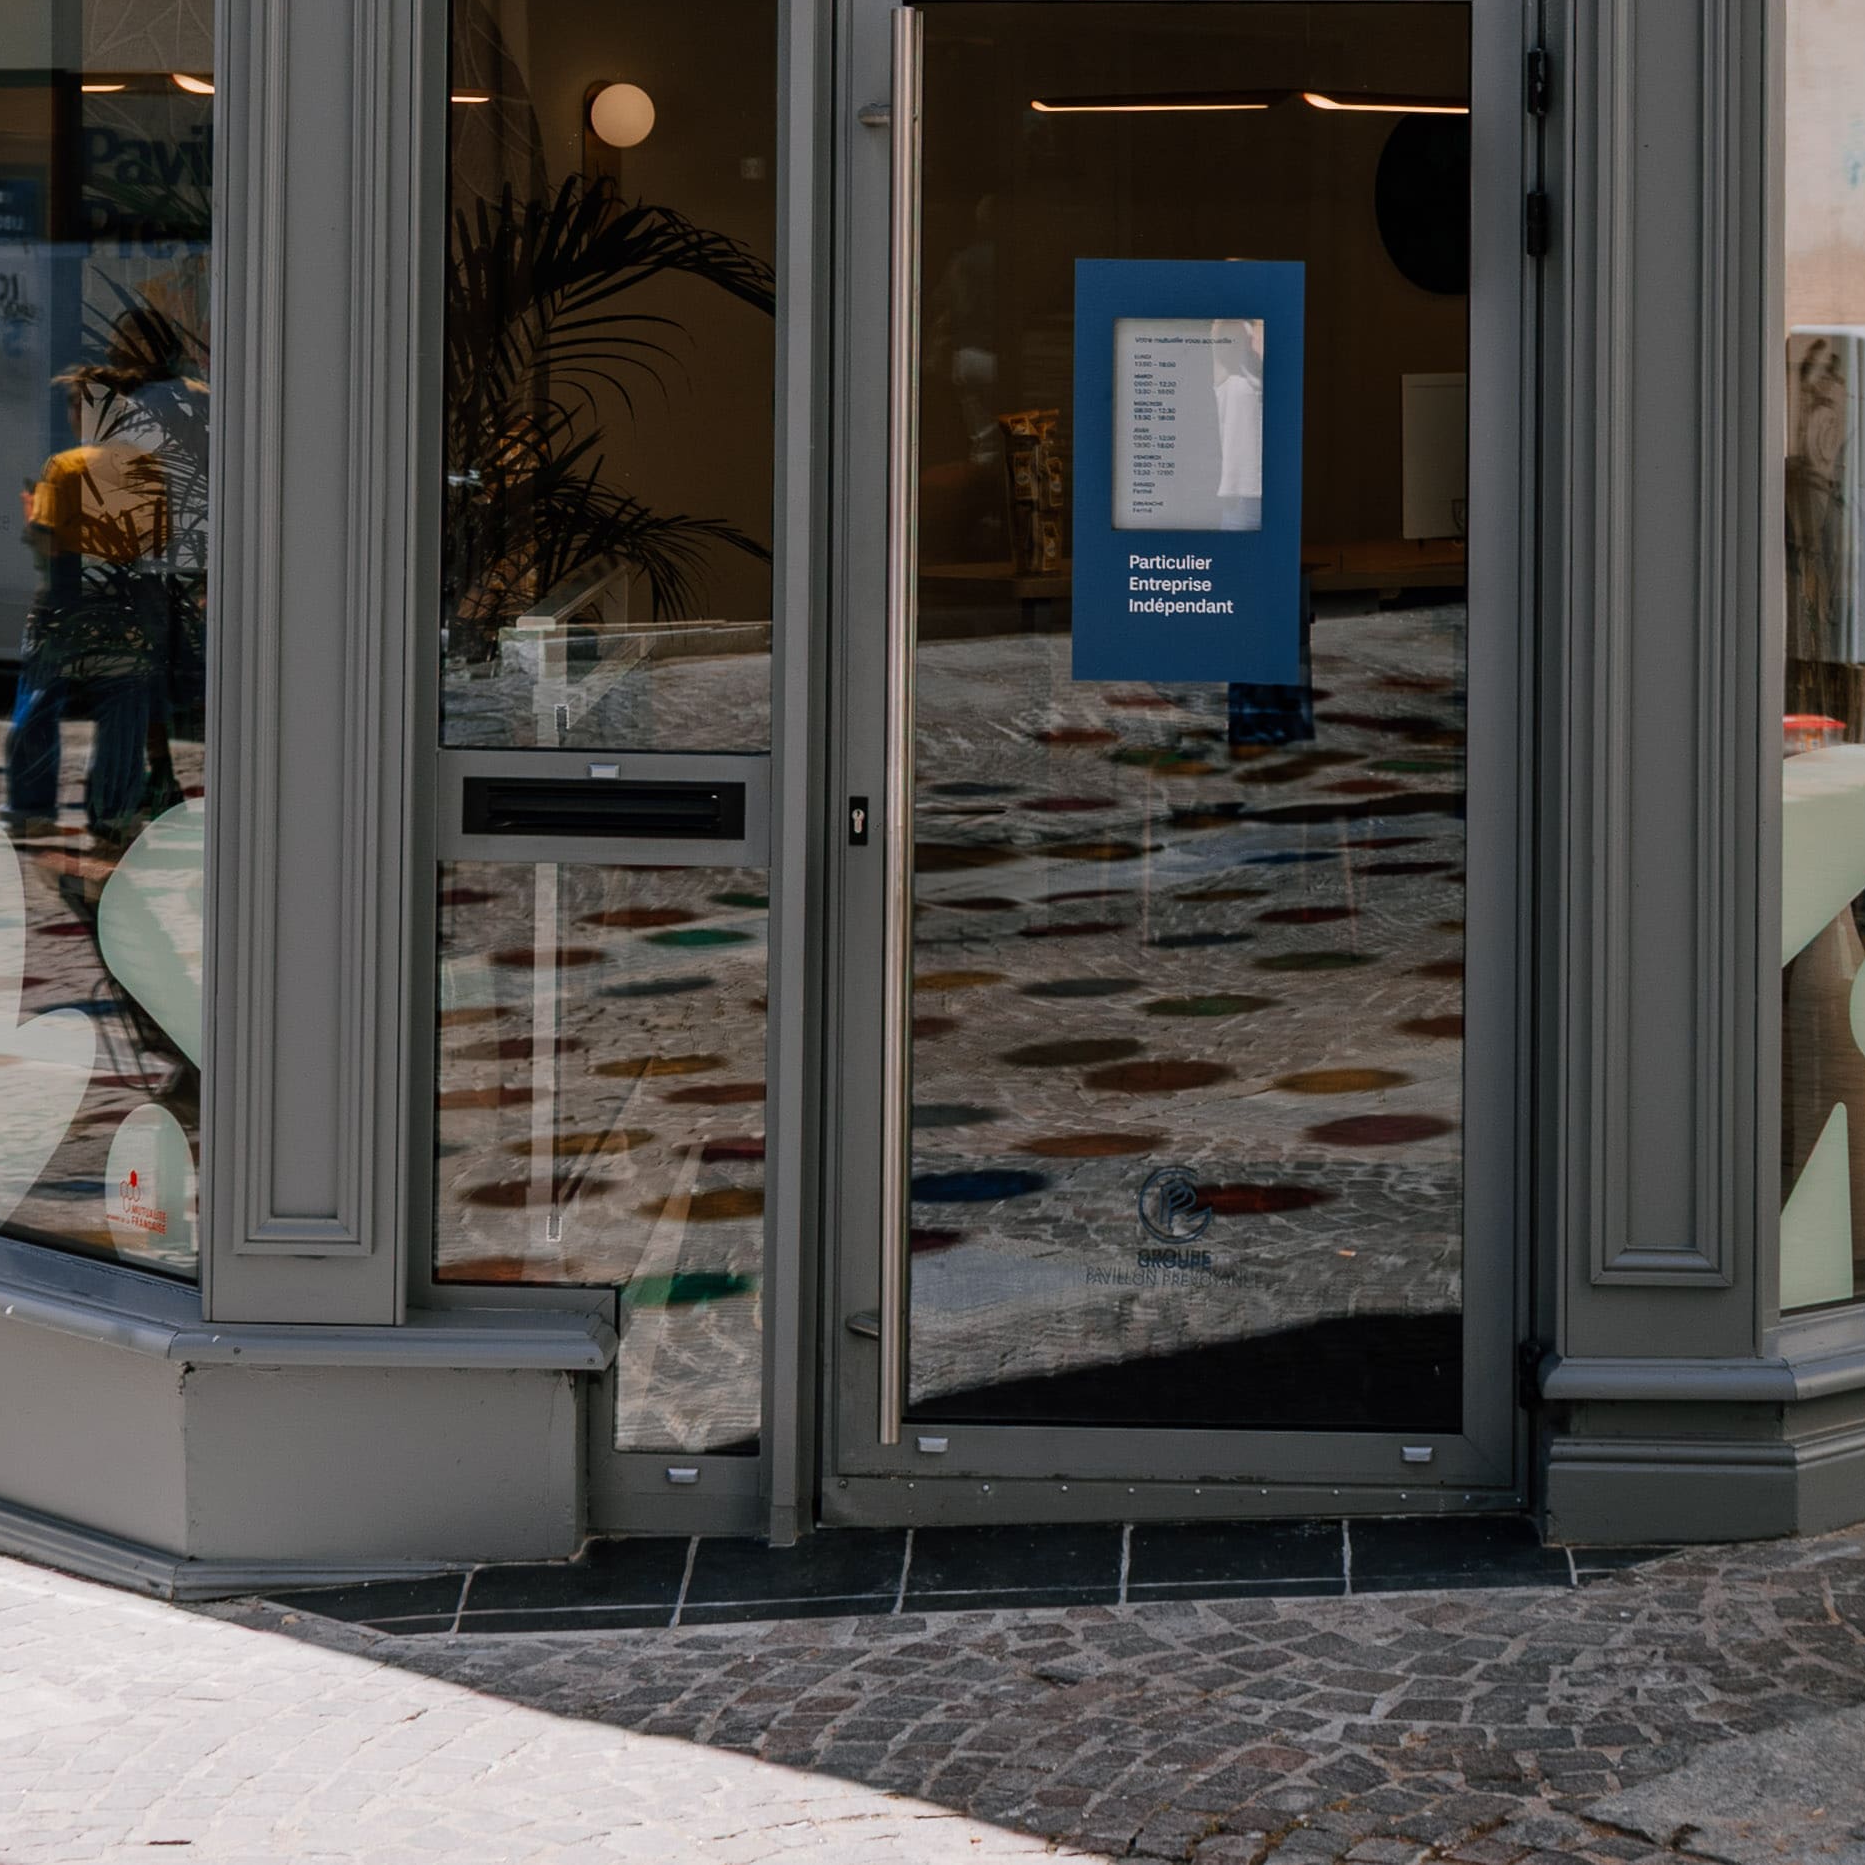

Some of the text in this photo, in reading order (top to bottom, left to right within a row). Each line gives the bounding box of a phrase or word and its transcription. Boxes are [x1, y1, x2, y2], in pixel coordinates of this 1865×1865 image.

[1129, 554, 1213, 570] Particulier
[1129, 576, 1212, 595] Entreprise
[1129, 597, 1234, 617] Indépendant
[1138, 1249, 1211, 1269] GROUPE
